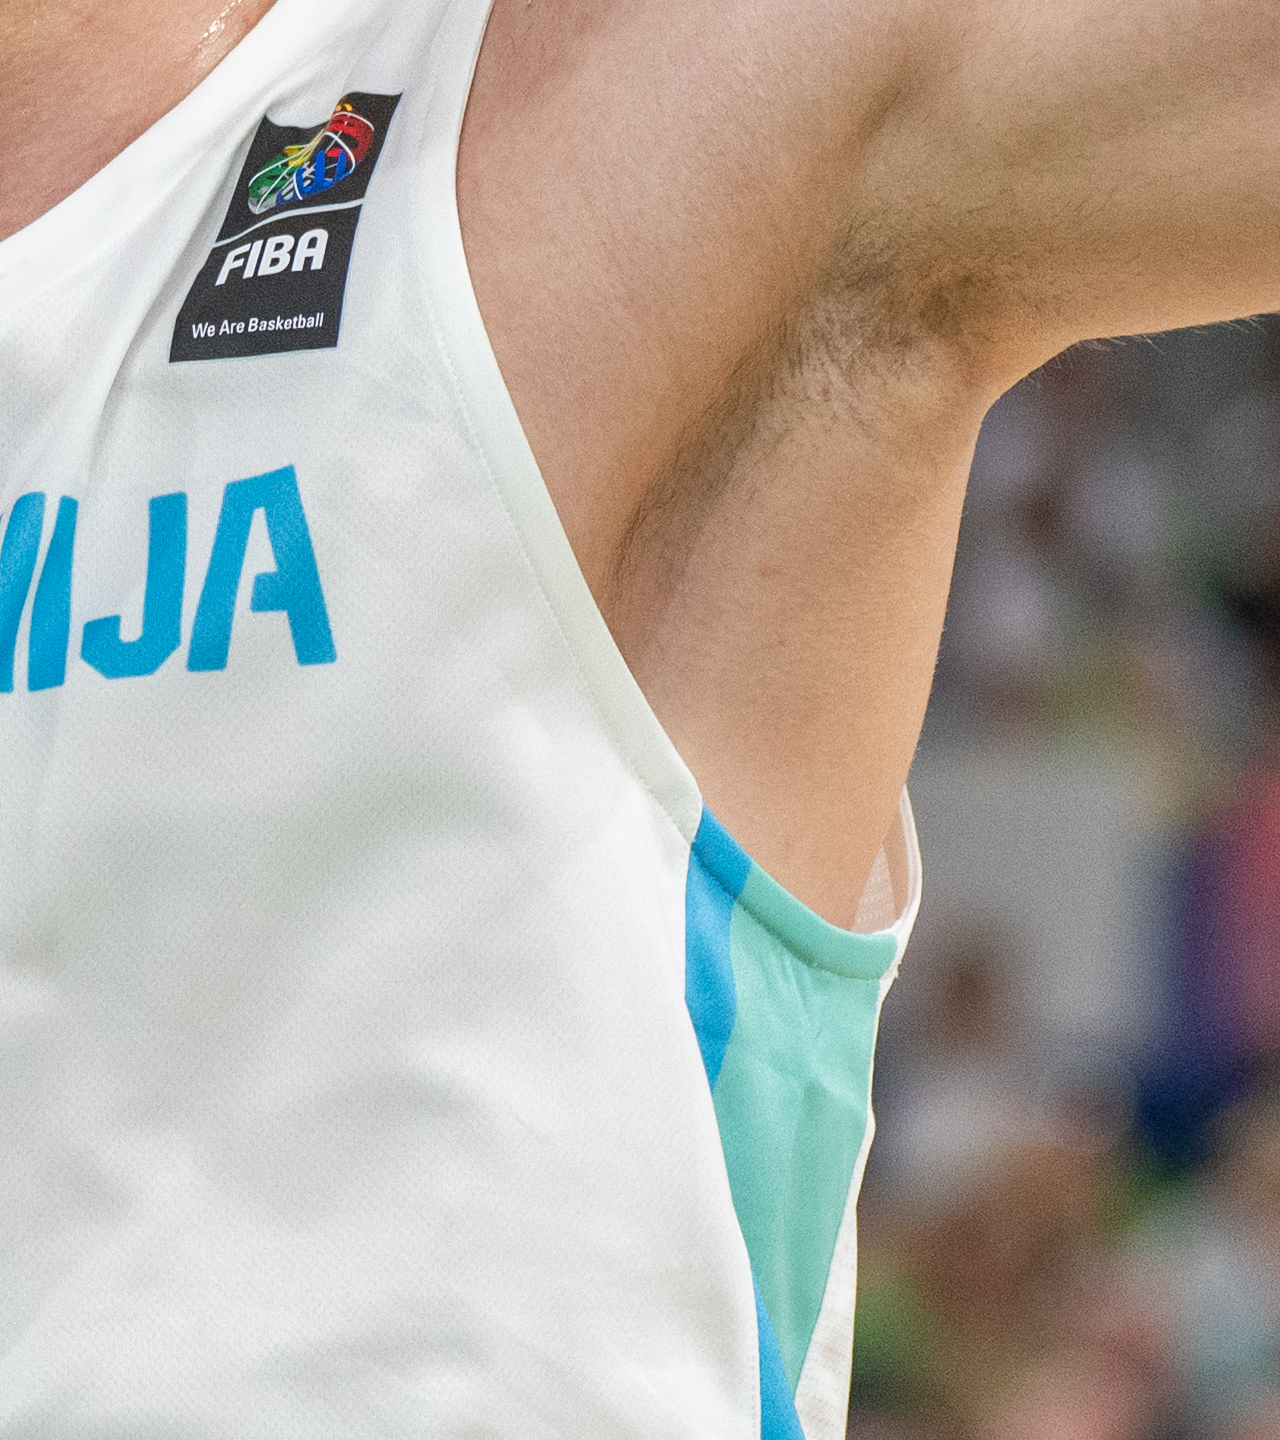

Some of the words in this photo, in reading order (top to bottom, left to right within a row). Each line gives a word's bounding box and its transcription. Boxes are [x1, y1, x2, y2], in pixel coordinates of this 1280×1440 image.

[214, 227, 329, 287] FIBA
[191, 321, 216, 339] We
[218, 319, 245, 336] Are
[247, 311, 324, 333] Basketball
